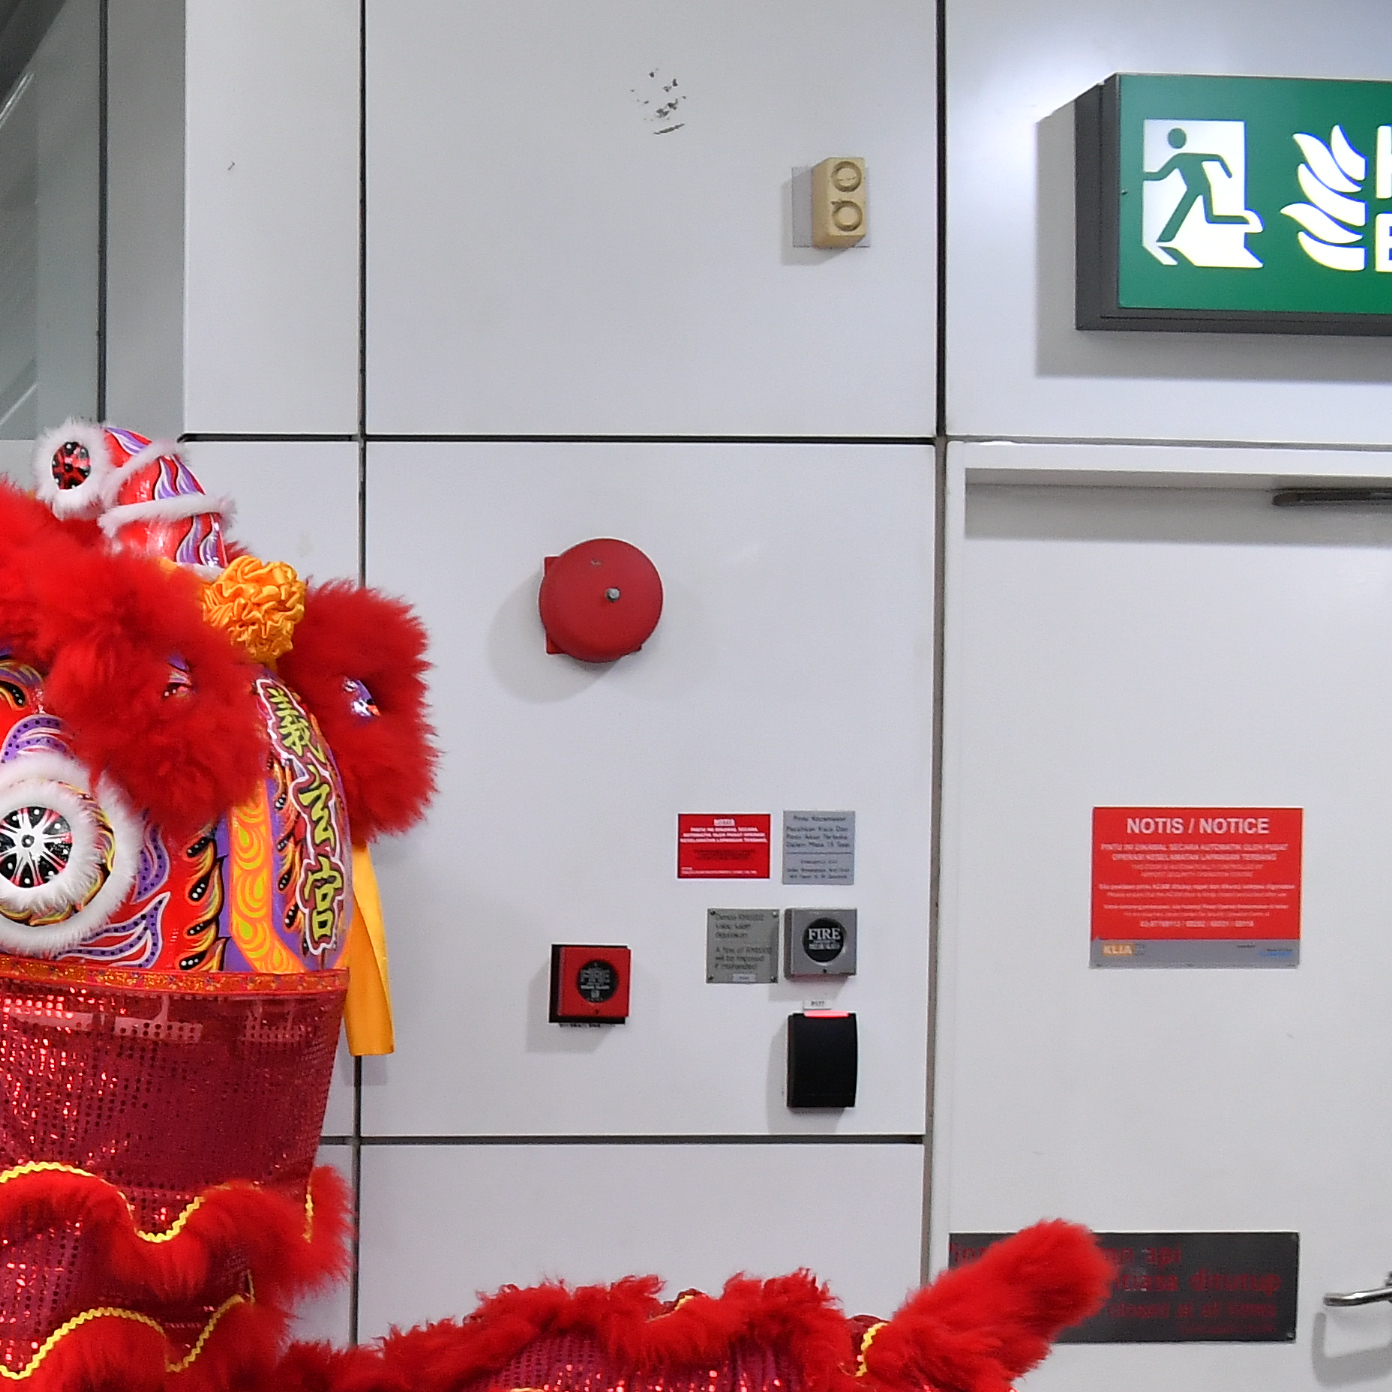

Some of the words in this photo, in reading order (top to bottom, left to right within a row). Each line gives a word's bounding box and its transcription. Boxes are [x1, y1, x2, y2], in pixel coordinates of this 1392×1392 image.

[1127, 818, 1184, 834] NOTIS
[1188, 818, 1195, 834] /
[1200, 818, 1270, 834] NOTICE
[808, 928, 841, 940] FIRE
